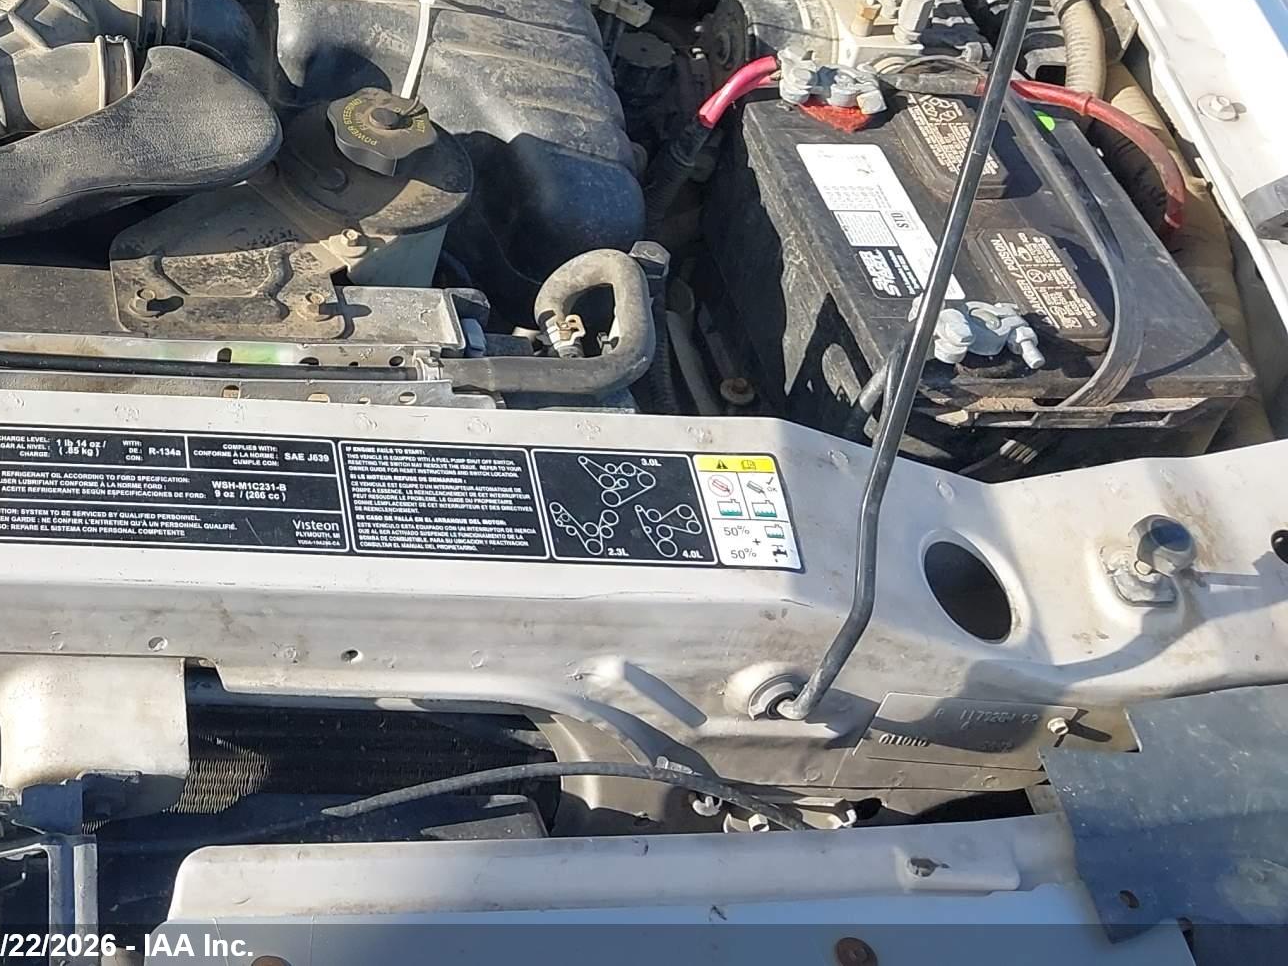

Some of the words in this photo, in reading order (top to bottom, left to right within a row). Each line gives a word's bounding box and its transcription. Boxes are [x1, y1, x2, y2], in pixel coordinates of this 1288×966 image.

[990, 238, 1018, 271] POISON
[1016, 279, 1047, 315] DANGER
[148, 448, 181, 456] R-134a
[641, 458, 662, 466] 3.0L
[212, 481, 286, 492] WSH-M1C231-B
[292, 520, 340, 531] Visteon
[723, 526, 750, 536] 50%
[608, 547, 629, 556] 2.3L
[682, 550, 703, 559] 4.0L
[730, 549, 757, 559] 50%
